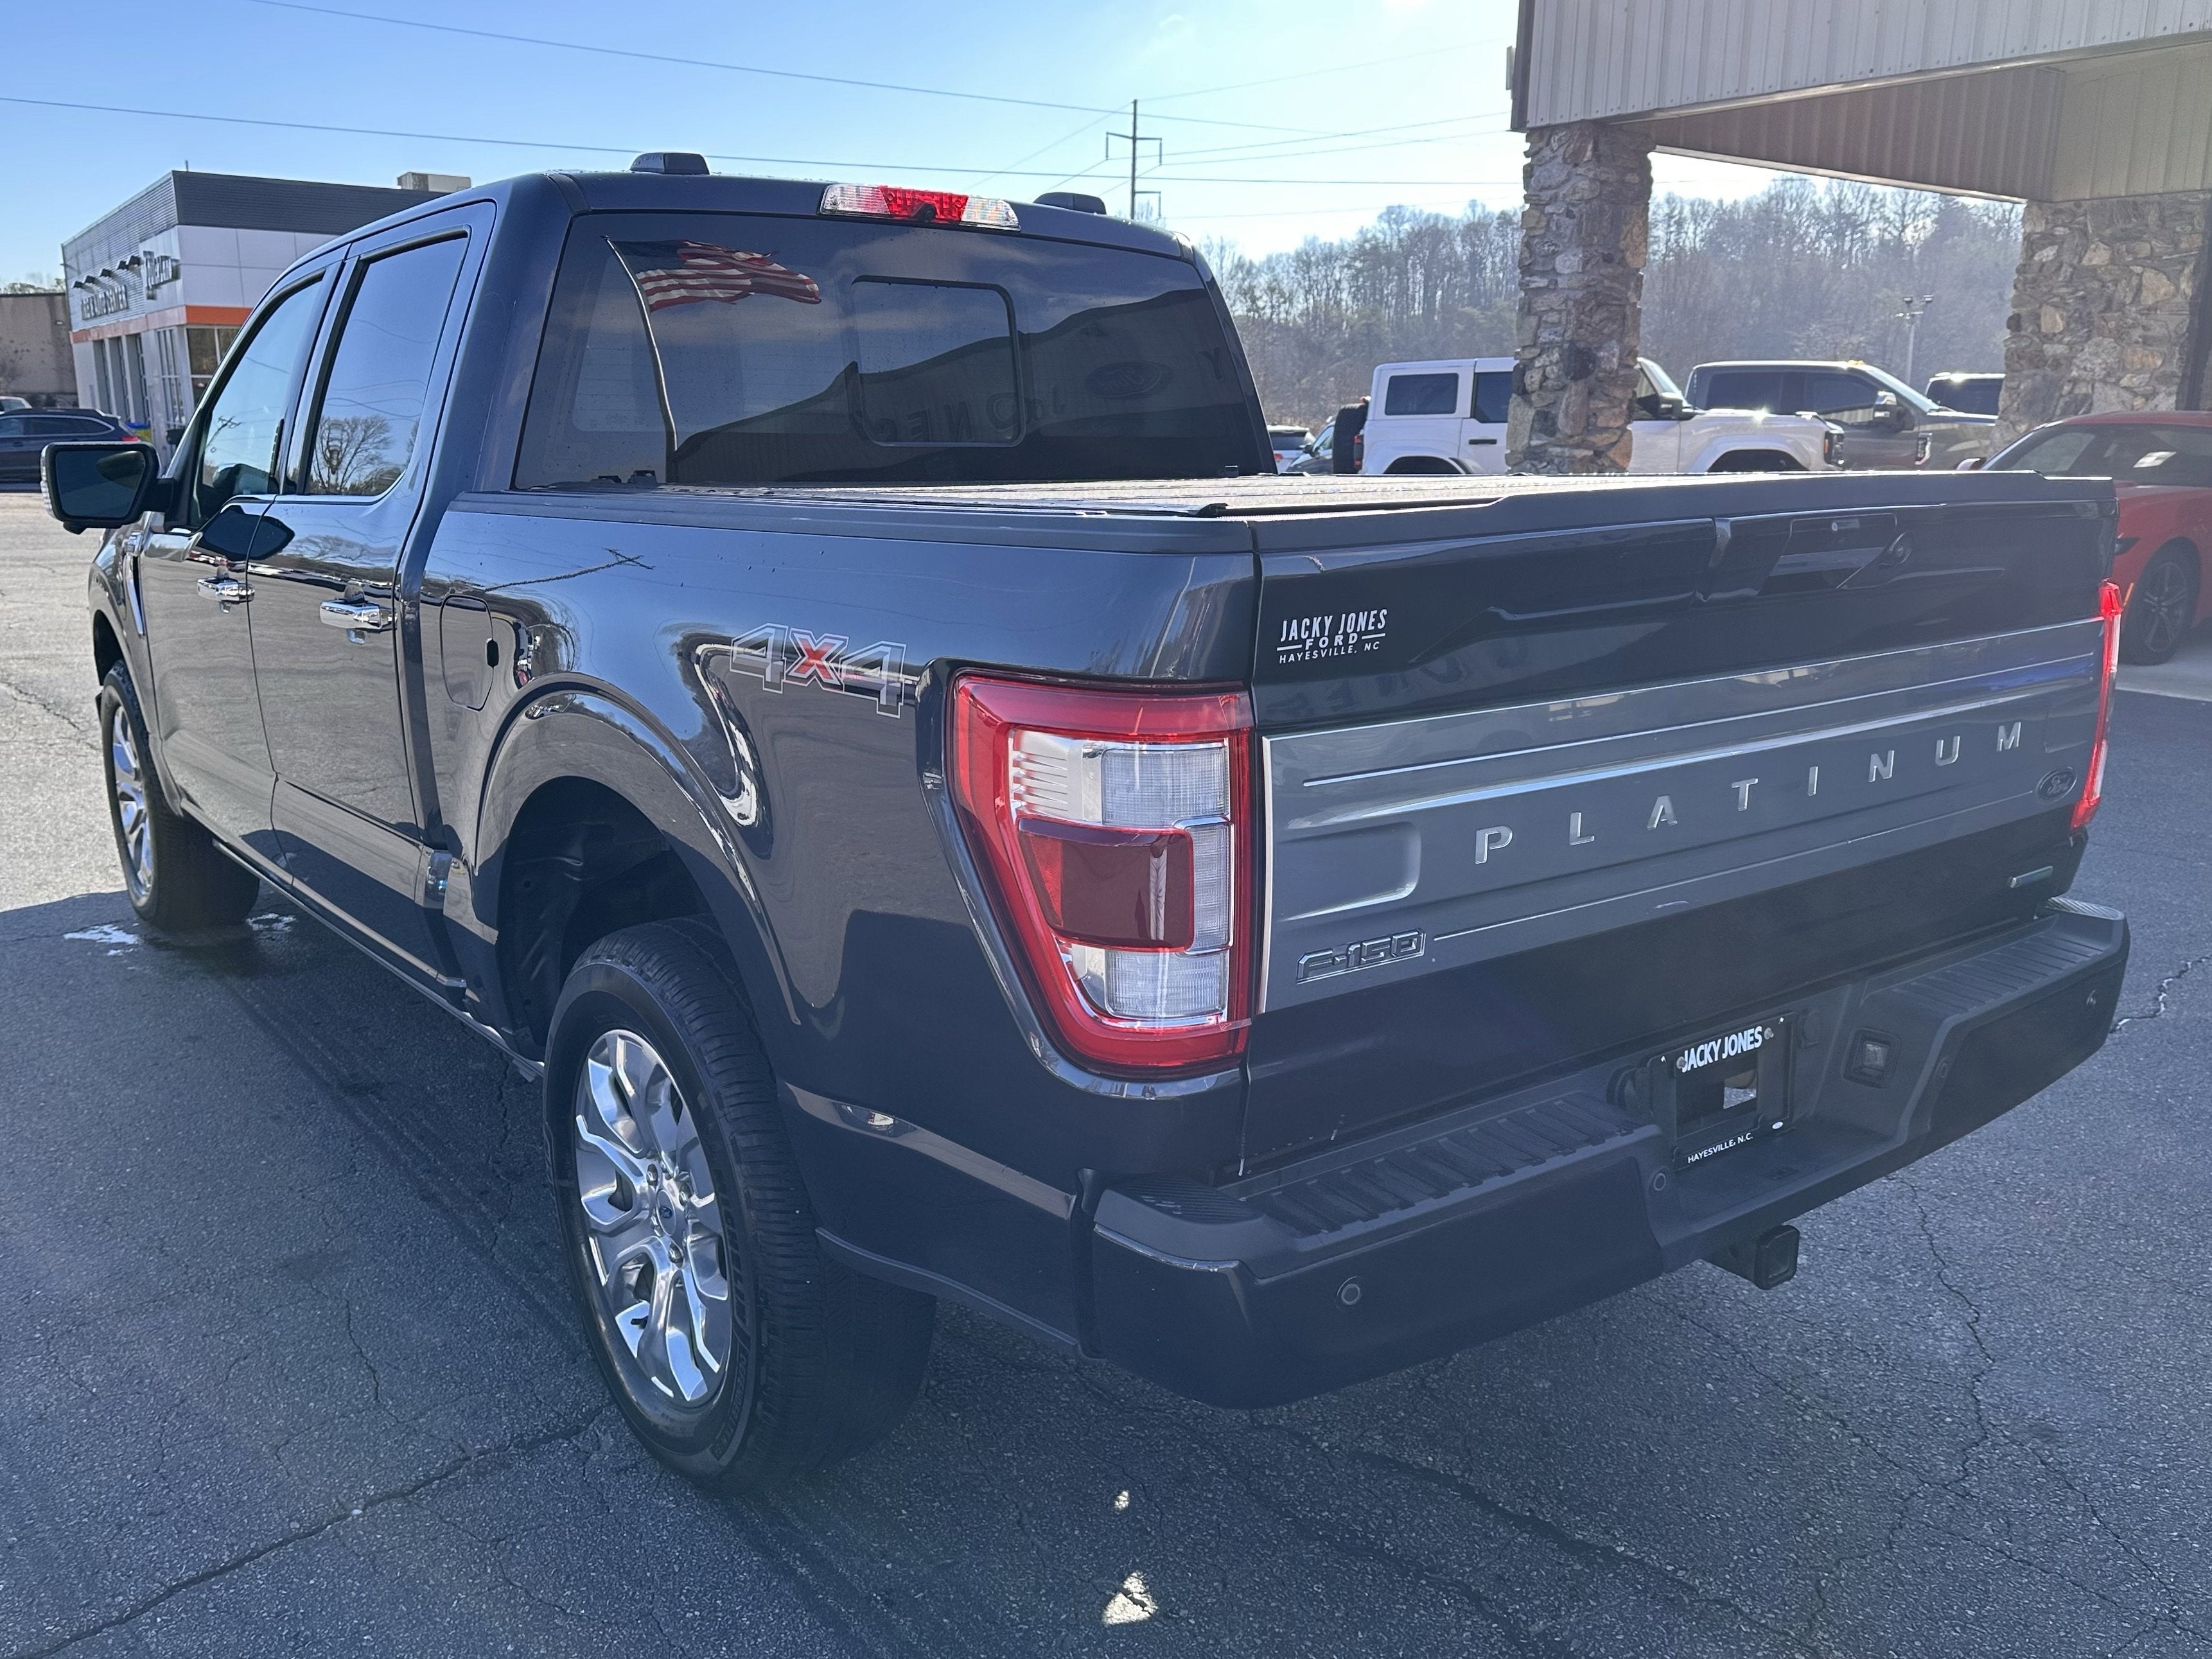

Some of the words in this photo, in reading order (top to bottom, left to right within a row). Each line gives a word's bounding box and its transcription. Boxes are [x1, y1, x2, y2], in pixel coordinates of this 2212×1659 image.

[1280, 615, 1333, 642] JACKY
[1338, 609, 1388, 635] JONES
[1304, 632, 1358, 651] FORD
[1279, 644, 1358, 664] HAYESVILLE,
[1364, 641, 1380, 651] NC
[1475, 721, 2023, 865] PLATINUM
[1295, 928, 1427, 984] F-150
[1681, 1038, 1722, 1073] JACKY
[1722, 1026, 1763, 1059] JONES
[1687, 1139, 1736, 1164] HAYESVILLE,
[1737, 1132, 1754, 1145] N.C.
